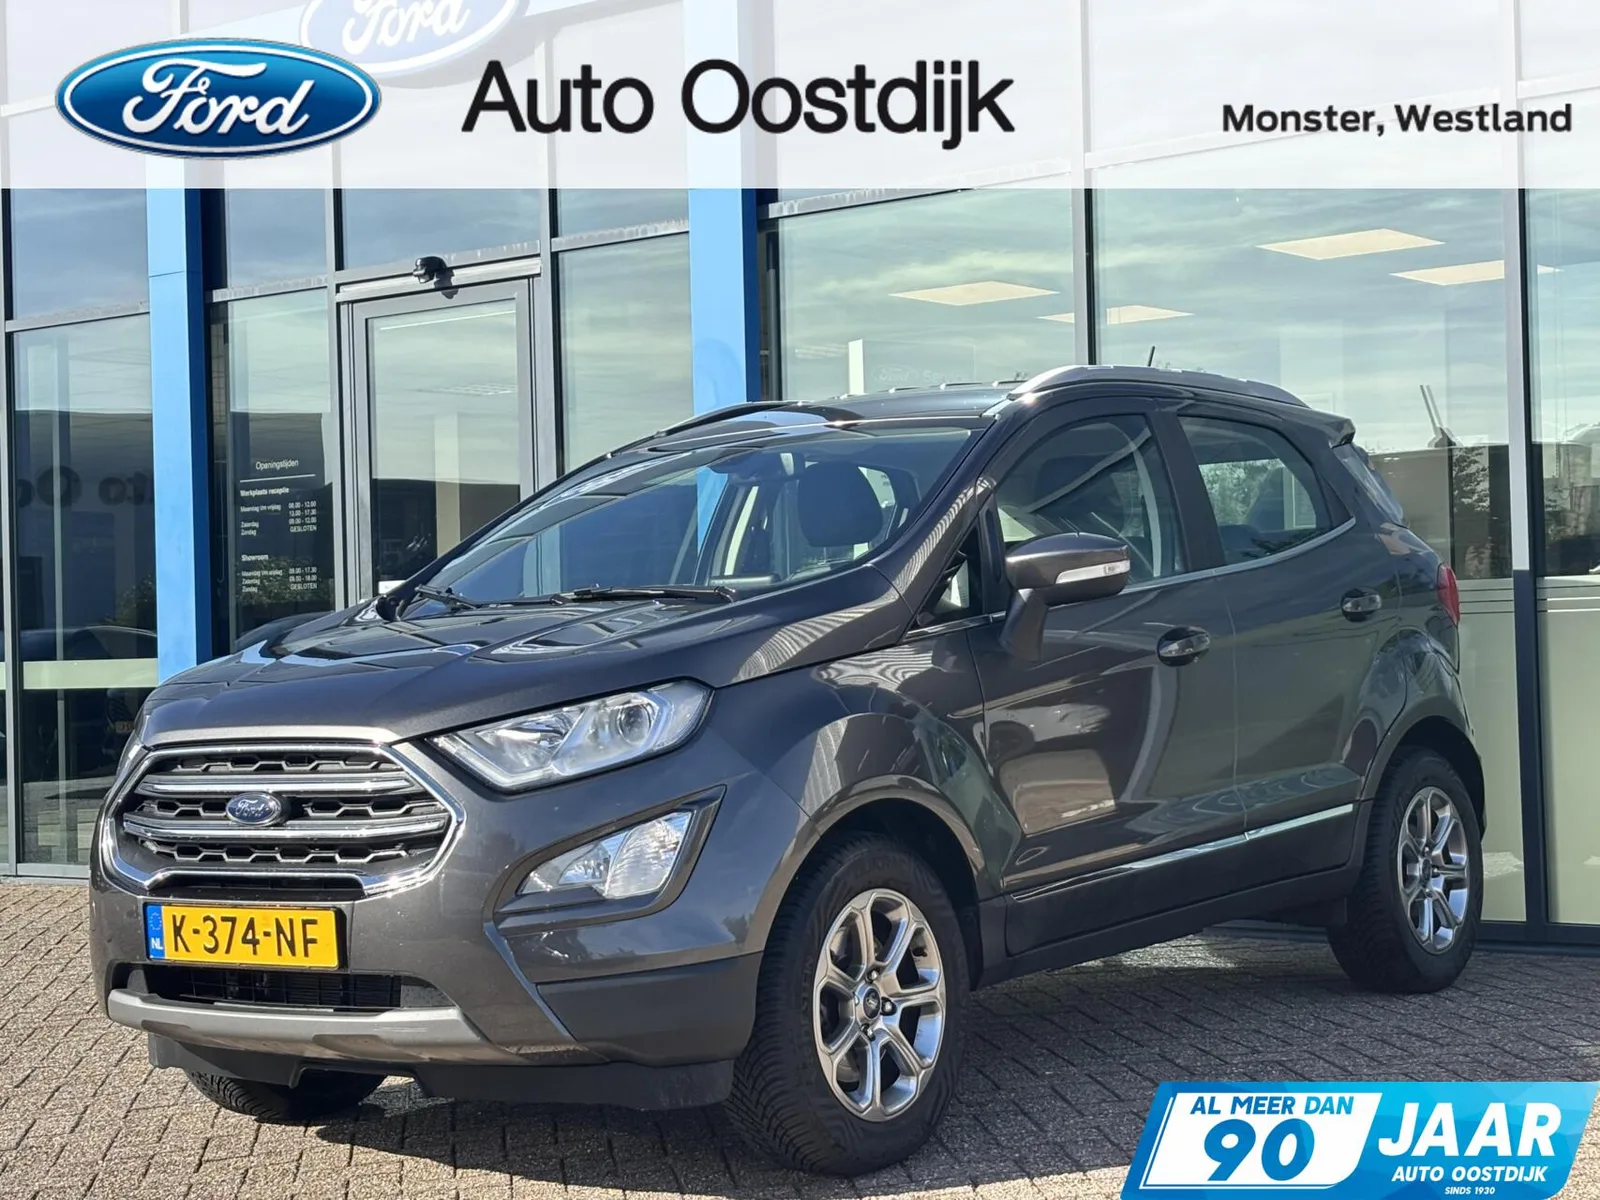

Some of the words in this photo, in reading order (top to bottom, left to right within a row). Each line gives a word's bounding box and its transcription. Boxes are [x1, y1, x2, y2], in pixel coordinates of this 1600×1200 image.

[256, 459, 299, 471] Openingstijden
[290, 524, 317, 533] GESLOTEN
[241, 554, 269, 562] Showroom
[290, 582, 318, 590] GESLOTEN
[172, 914, 319, 957] K-374-NF
[151, 938, 164, 950] NL
